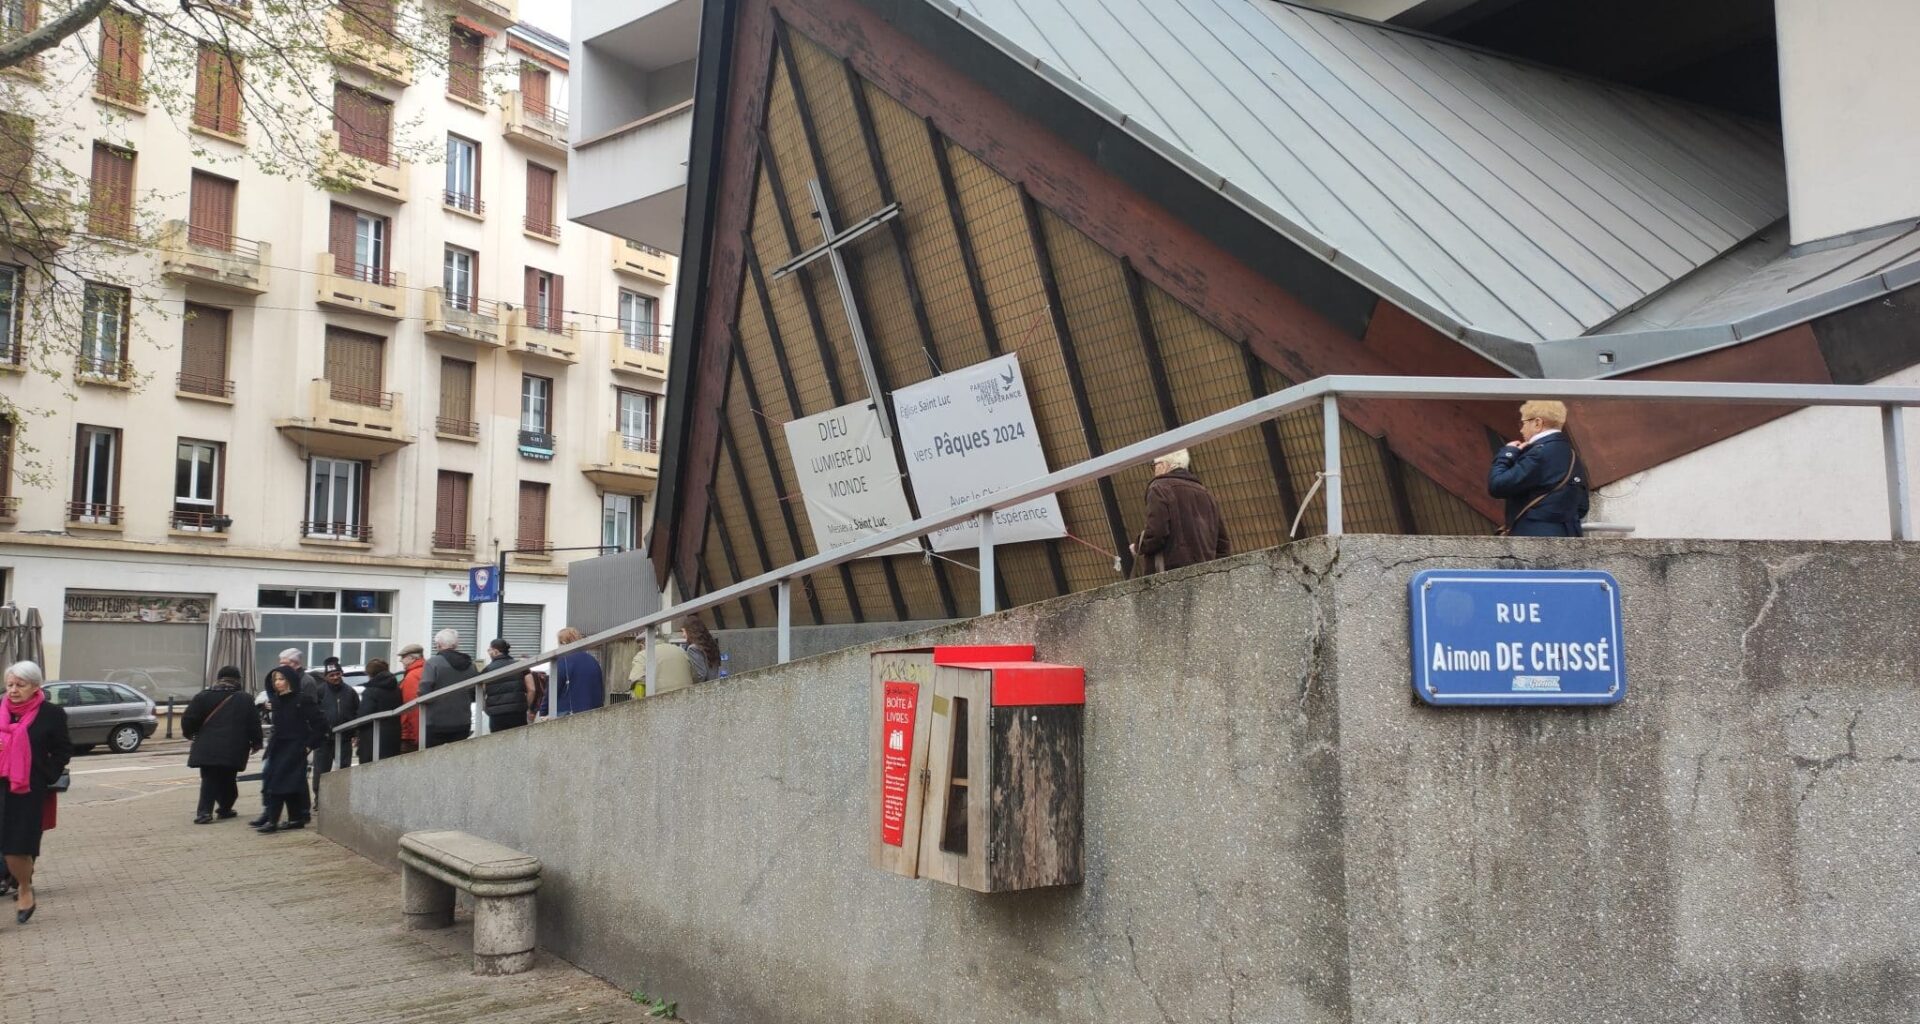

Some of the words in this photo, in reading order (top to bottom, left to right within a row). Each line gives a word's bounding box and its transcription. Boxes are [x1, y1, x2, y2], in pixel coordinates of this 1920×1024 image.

[919, 397, 937, 412] Saint
[938, 395, 952, 407] Luc
[818, 415, 848, 441] DIEU
[913, 447, 934, 462] vers
[934, 429, 990, 458] Pâques
[993, 421, 1025, 444] 2024
[811, 449, 855, 473] LUMIERE
[854, 444, 872, 464] DU
[828, 475, 869, 498] MONDE
[853, 517, 873, 531] Saint
[873, 515, 888, 528] Luc
[1496, 603, 1541, 623] RUE
[1432, 641, 1491, 672] Aimon
[1496, 642, 1525, 672] DE
[1530, 636, 1611, 672] CHISSÉ
[886, 711, 909, 724] LIVRES
